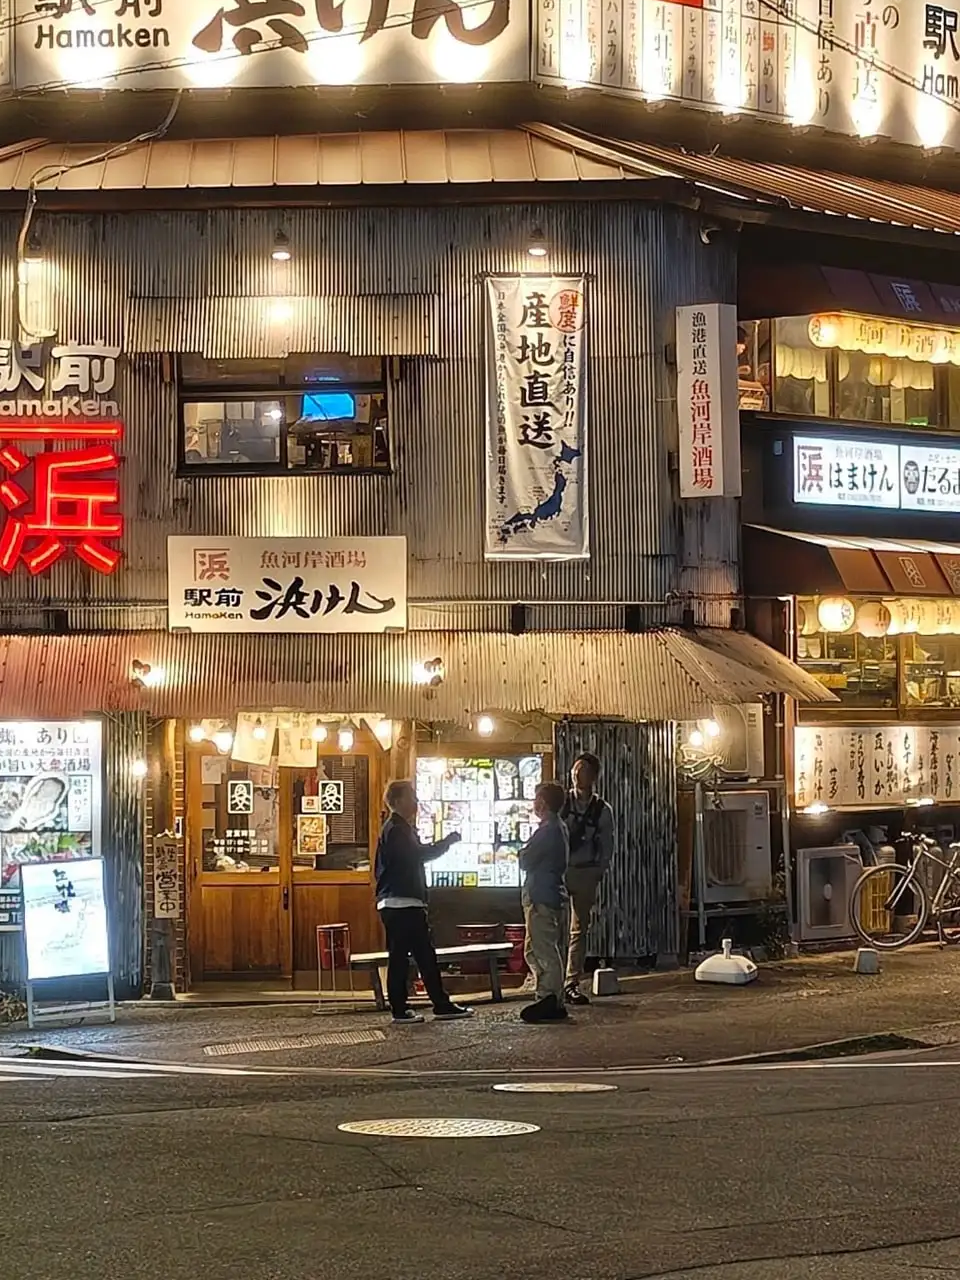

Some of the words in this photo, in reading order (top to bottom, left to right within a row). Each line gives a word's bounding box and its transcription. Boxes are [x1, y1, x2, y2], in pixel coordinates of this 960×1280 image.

[923, 3, 960, 61] 駅
[691, 311, 708, 376] 漁港直送
[516, 291, 558, 451] 産地直送
[690, 378, 716, 490] 魚河岸酒場
[828, 462, 894, 494] はまけん
[194, 548, 230, 581] 浜
[260, 550, 366, 569] 魚河岸酒場
[184, 588, 243, 607] 駅前
[249, 576, 396, 620] 浜けん
